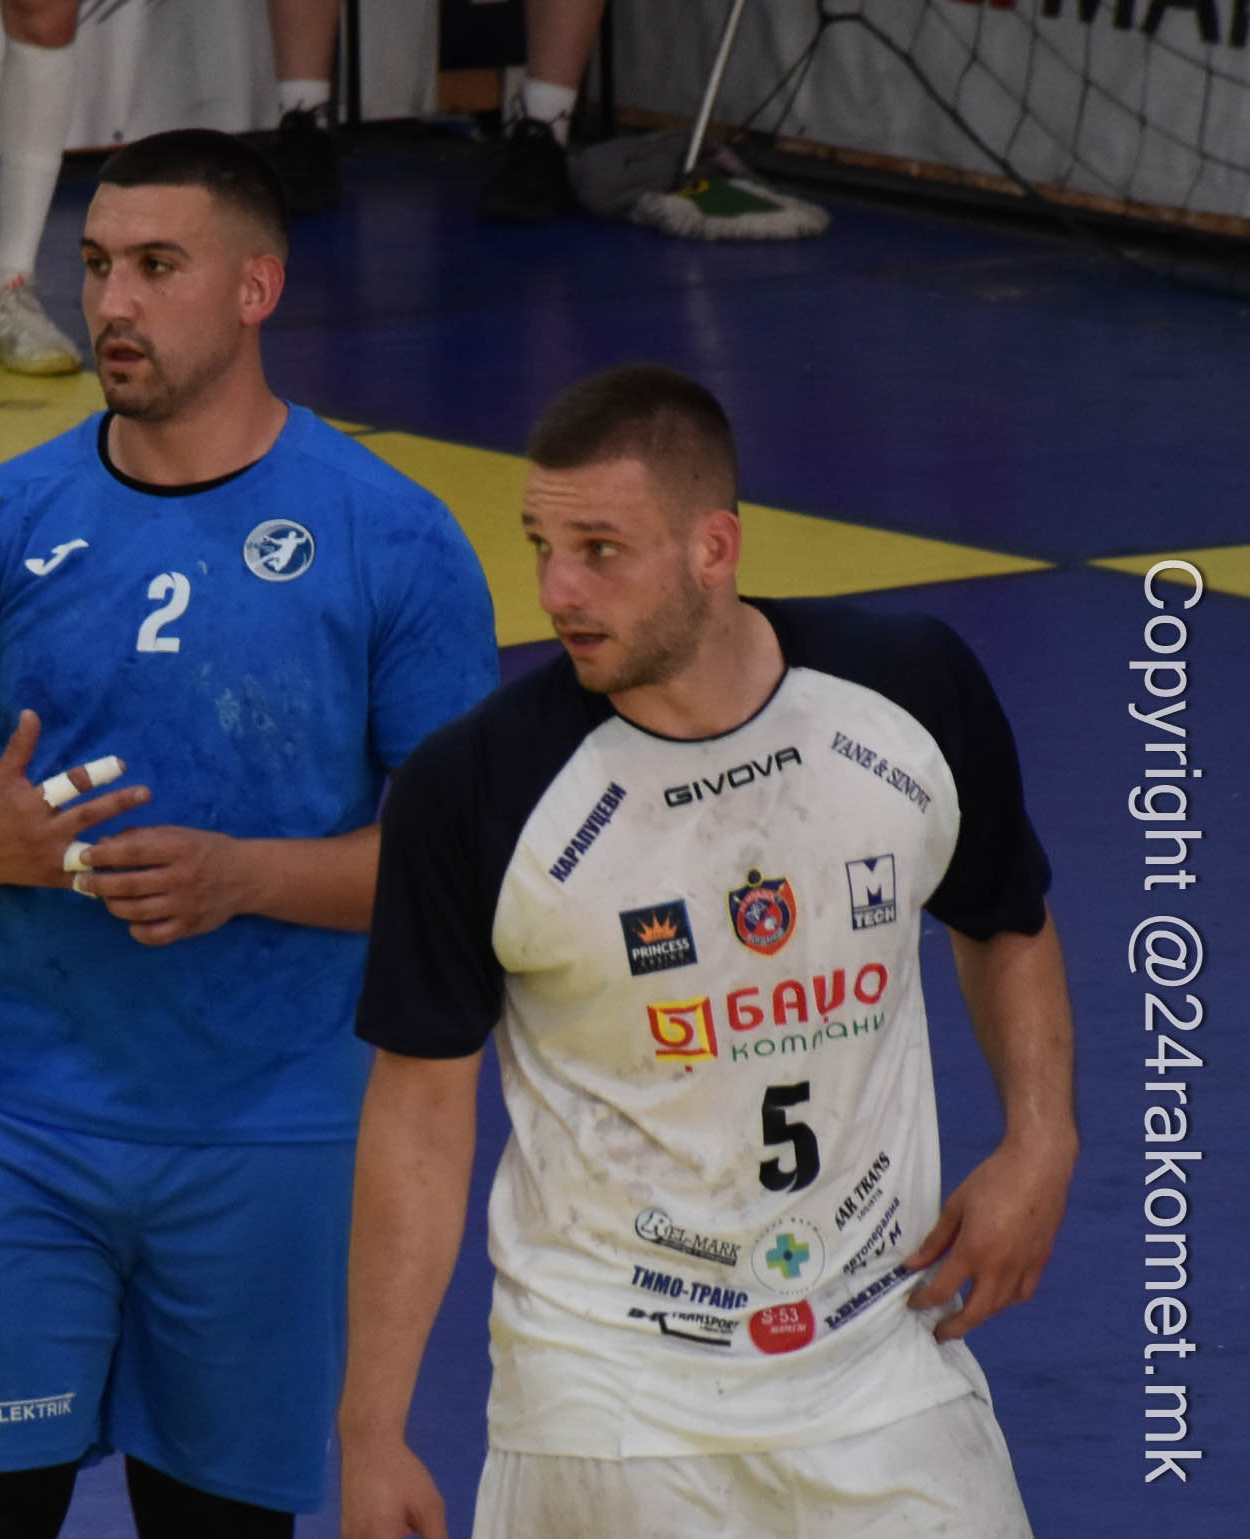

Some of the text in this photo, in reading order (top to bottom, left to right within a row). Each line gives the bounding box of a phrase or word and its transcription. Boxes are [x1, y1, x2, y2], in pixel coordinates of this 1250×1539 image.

[136, 571, 190, 653] 2
[664, 747, 802, 808] GIVOVA
[831, 731, 932, 814] VANE & SINOVI
[549, 782, 628, 882] КАРАПУЦЕВИ
[632, 938, 690, 961] PRINCESS
[759, 1080, 820, 1193] 5
[631, 1265, 749, 1310] ТИМО-ТРАНС
